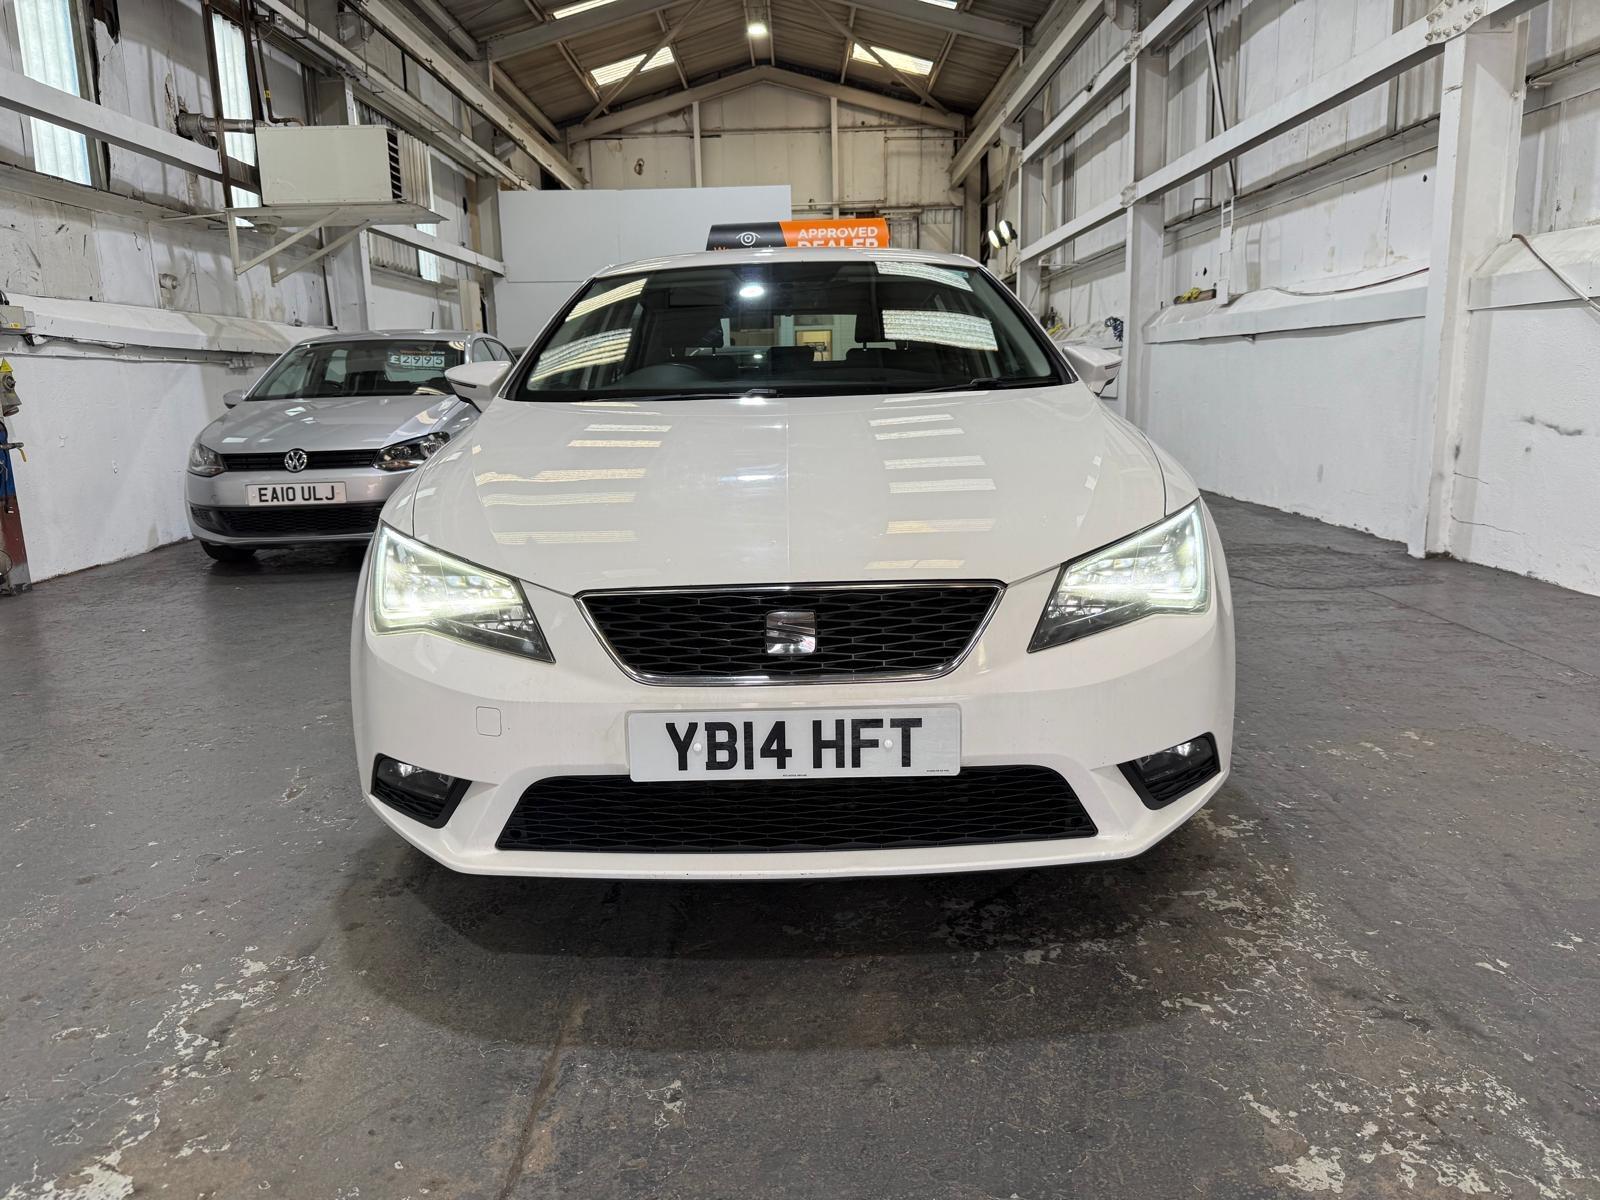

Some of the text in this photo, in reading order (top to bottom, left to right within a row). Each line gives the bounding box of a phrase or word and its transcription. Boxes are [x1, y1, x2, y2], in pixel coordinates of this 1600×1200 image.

[798, 226, 878, 239] APPROVED
[390, 355, 444, 366] £2995
[258, 485, 335, 502] EA10 ULJ
[665, 718, 922, 771] YB14 HFT
